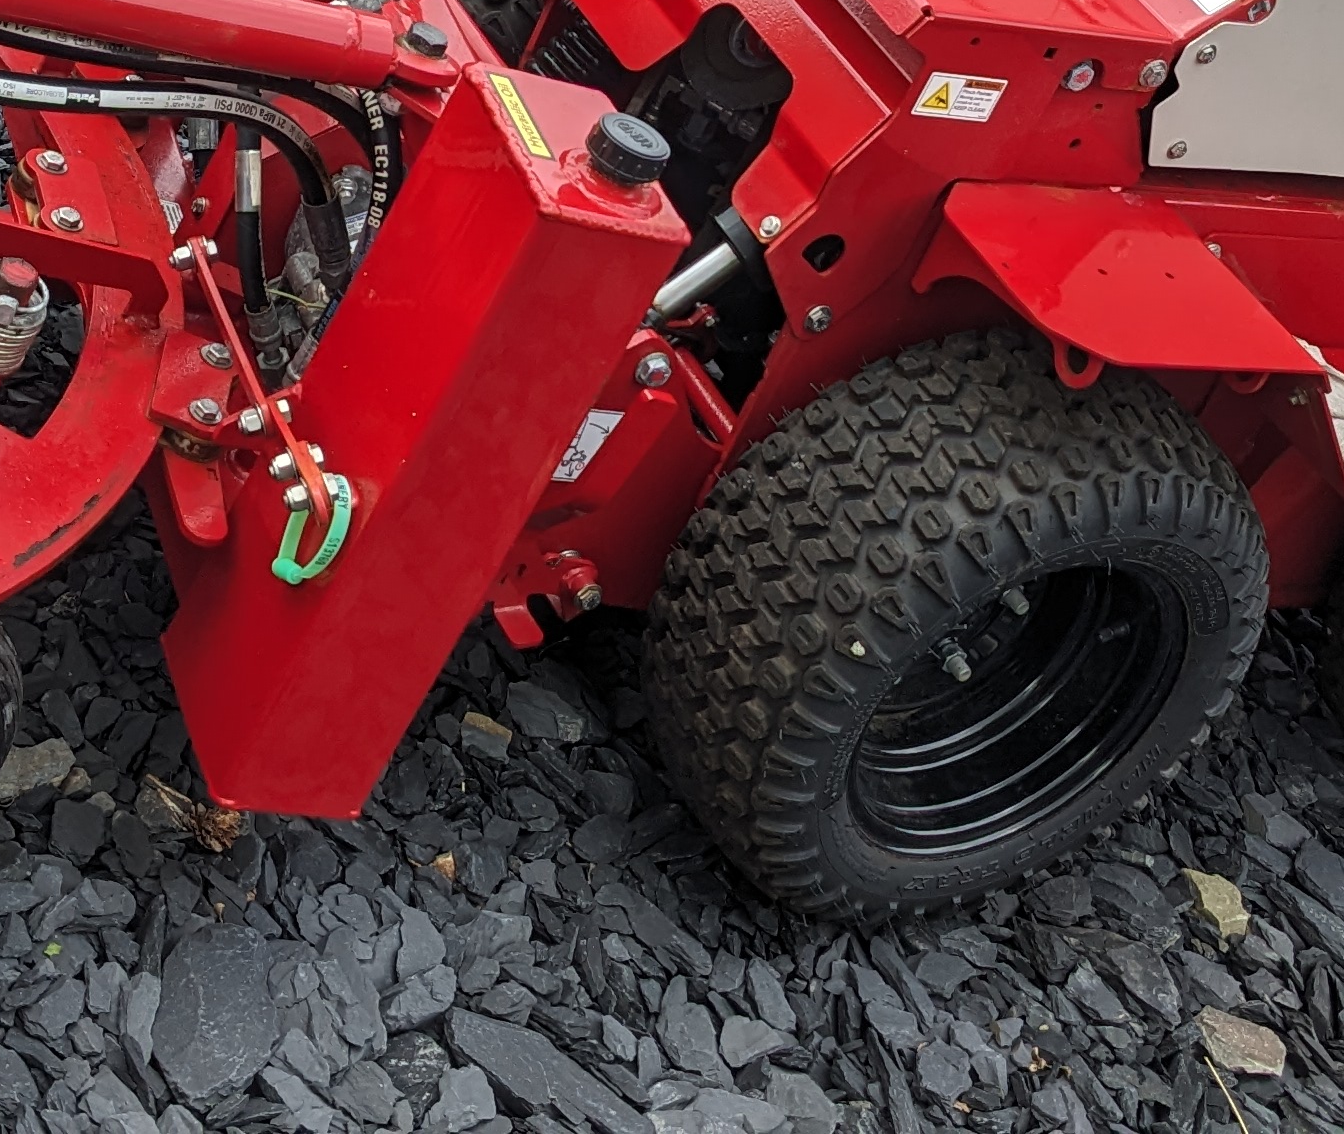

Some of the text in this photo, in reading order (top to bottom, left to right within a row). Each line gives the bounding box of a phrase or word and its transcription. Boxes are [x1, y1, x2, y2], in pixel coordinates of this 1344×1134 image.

[25, 87, 65, 98] GLOBALCORE
[68, 92, 100, 104] Parker
[214, 97, 287, 129] 21 MPa (3000 PSI)
[497, 82, 543, 148] Hydraulic Oil
[359, 88, 388, 229] NER EC118-08
